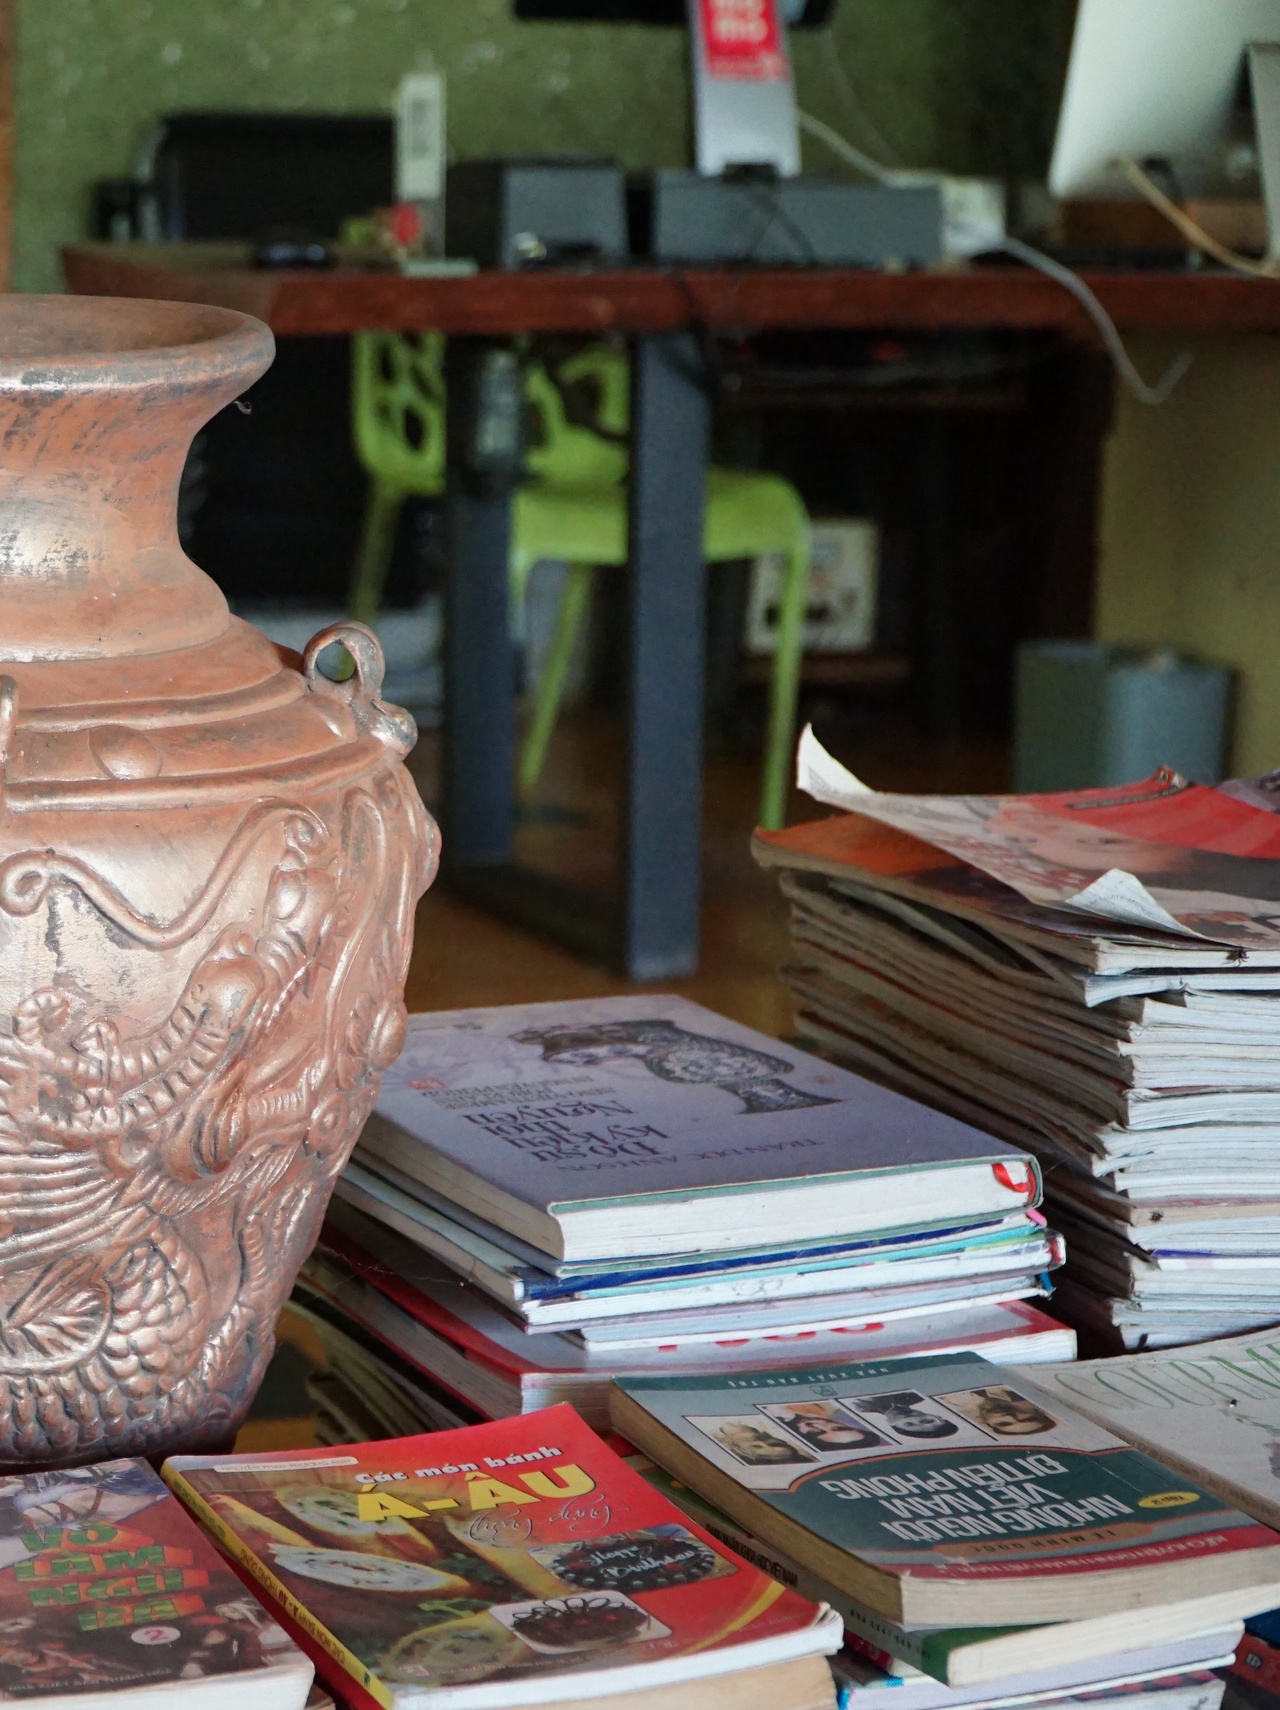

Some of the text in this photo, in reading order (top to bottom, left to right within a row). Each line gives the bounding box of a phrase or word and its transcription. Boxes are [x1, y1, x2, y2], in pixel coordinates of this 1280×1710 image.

[355, 1446, 563, 1484] Các món bánh
[818, 1470, 959, 1500] PHONG
[878, 1491, 987, 1519] NAM
